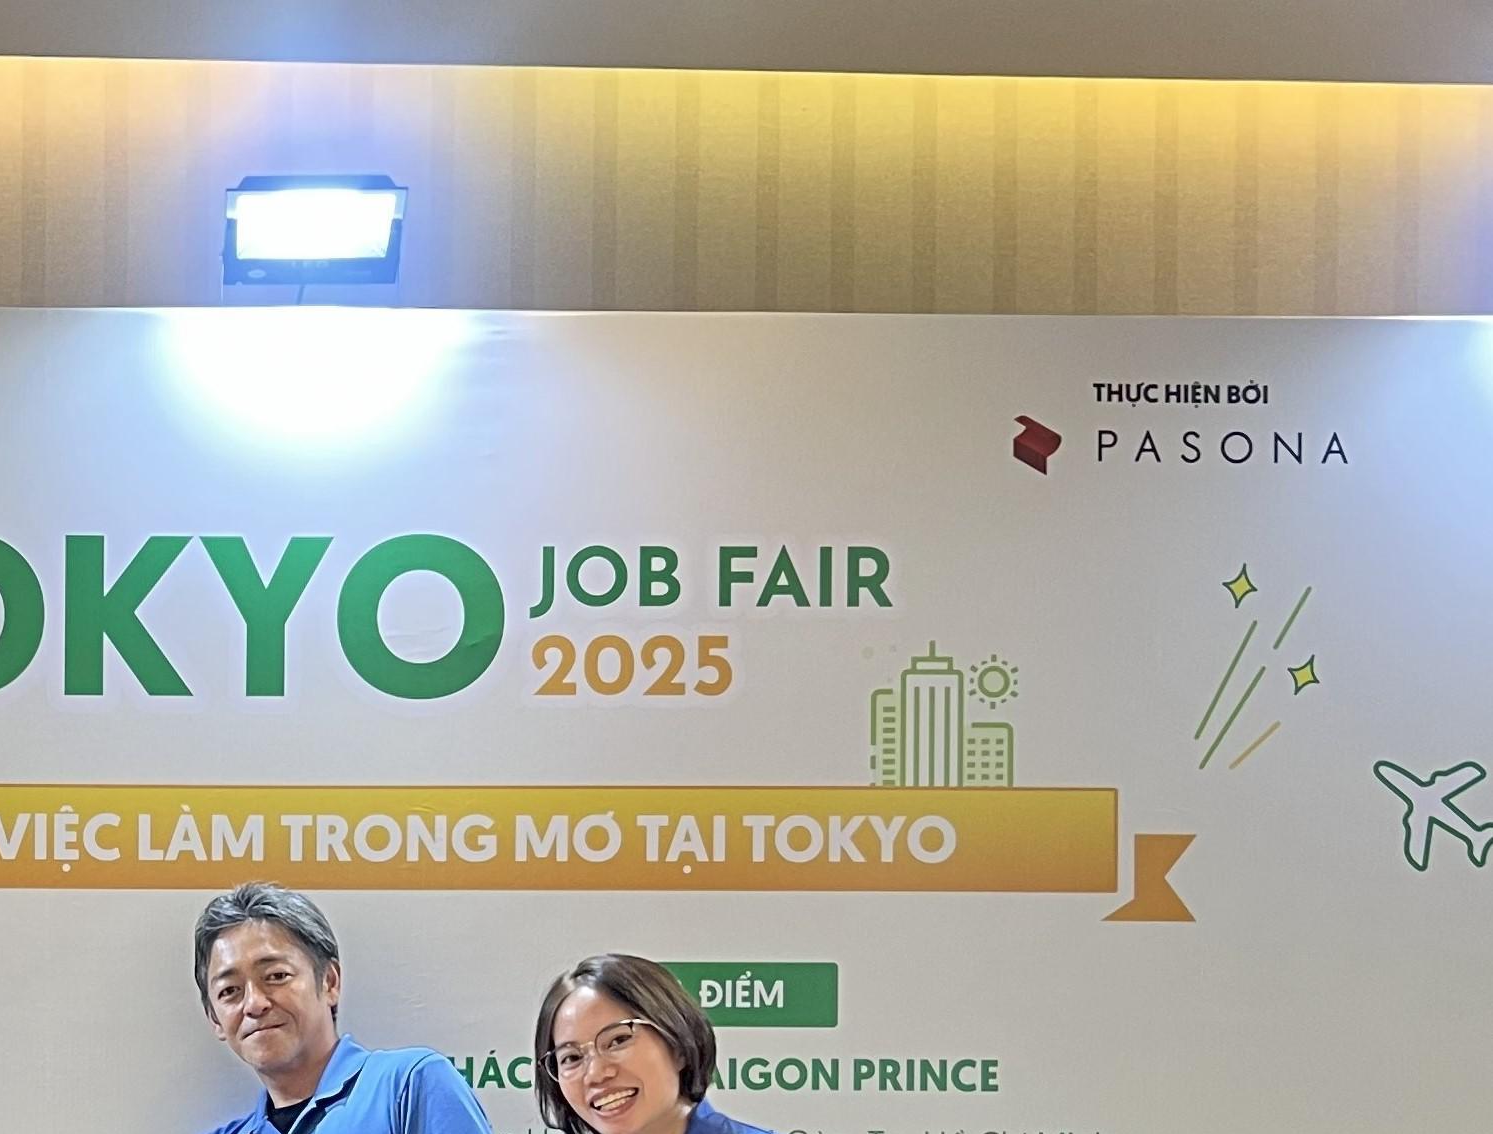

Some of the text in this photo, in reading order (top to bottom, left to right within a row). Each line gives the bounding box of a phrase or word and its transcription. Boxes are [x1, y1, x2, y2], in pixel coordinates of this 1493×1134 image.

[1092, 382, 1159, 408] THỰC
[1164, 381, 1221, 408] HIỆN
[1097, 429, 1349, 465] PASONA
[529, 543, 894, 620] JOB FAIR
[531, 634, 734, 697] 2025
[137, 803, 265, 863] LÀM
[279, 813, 498, 863] TRONG
[514, 810, 623, 864] MƠ
[636, 814, 727, 875] TẠI
[742, 814, 957, 864] TOKYO
[698, 970, 785, 1010] ĐIỂM
[852, 1058, 1000, 1093] PRINCE
